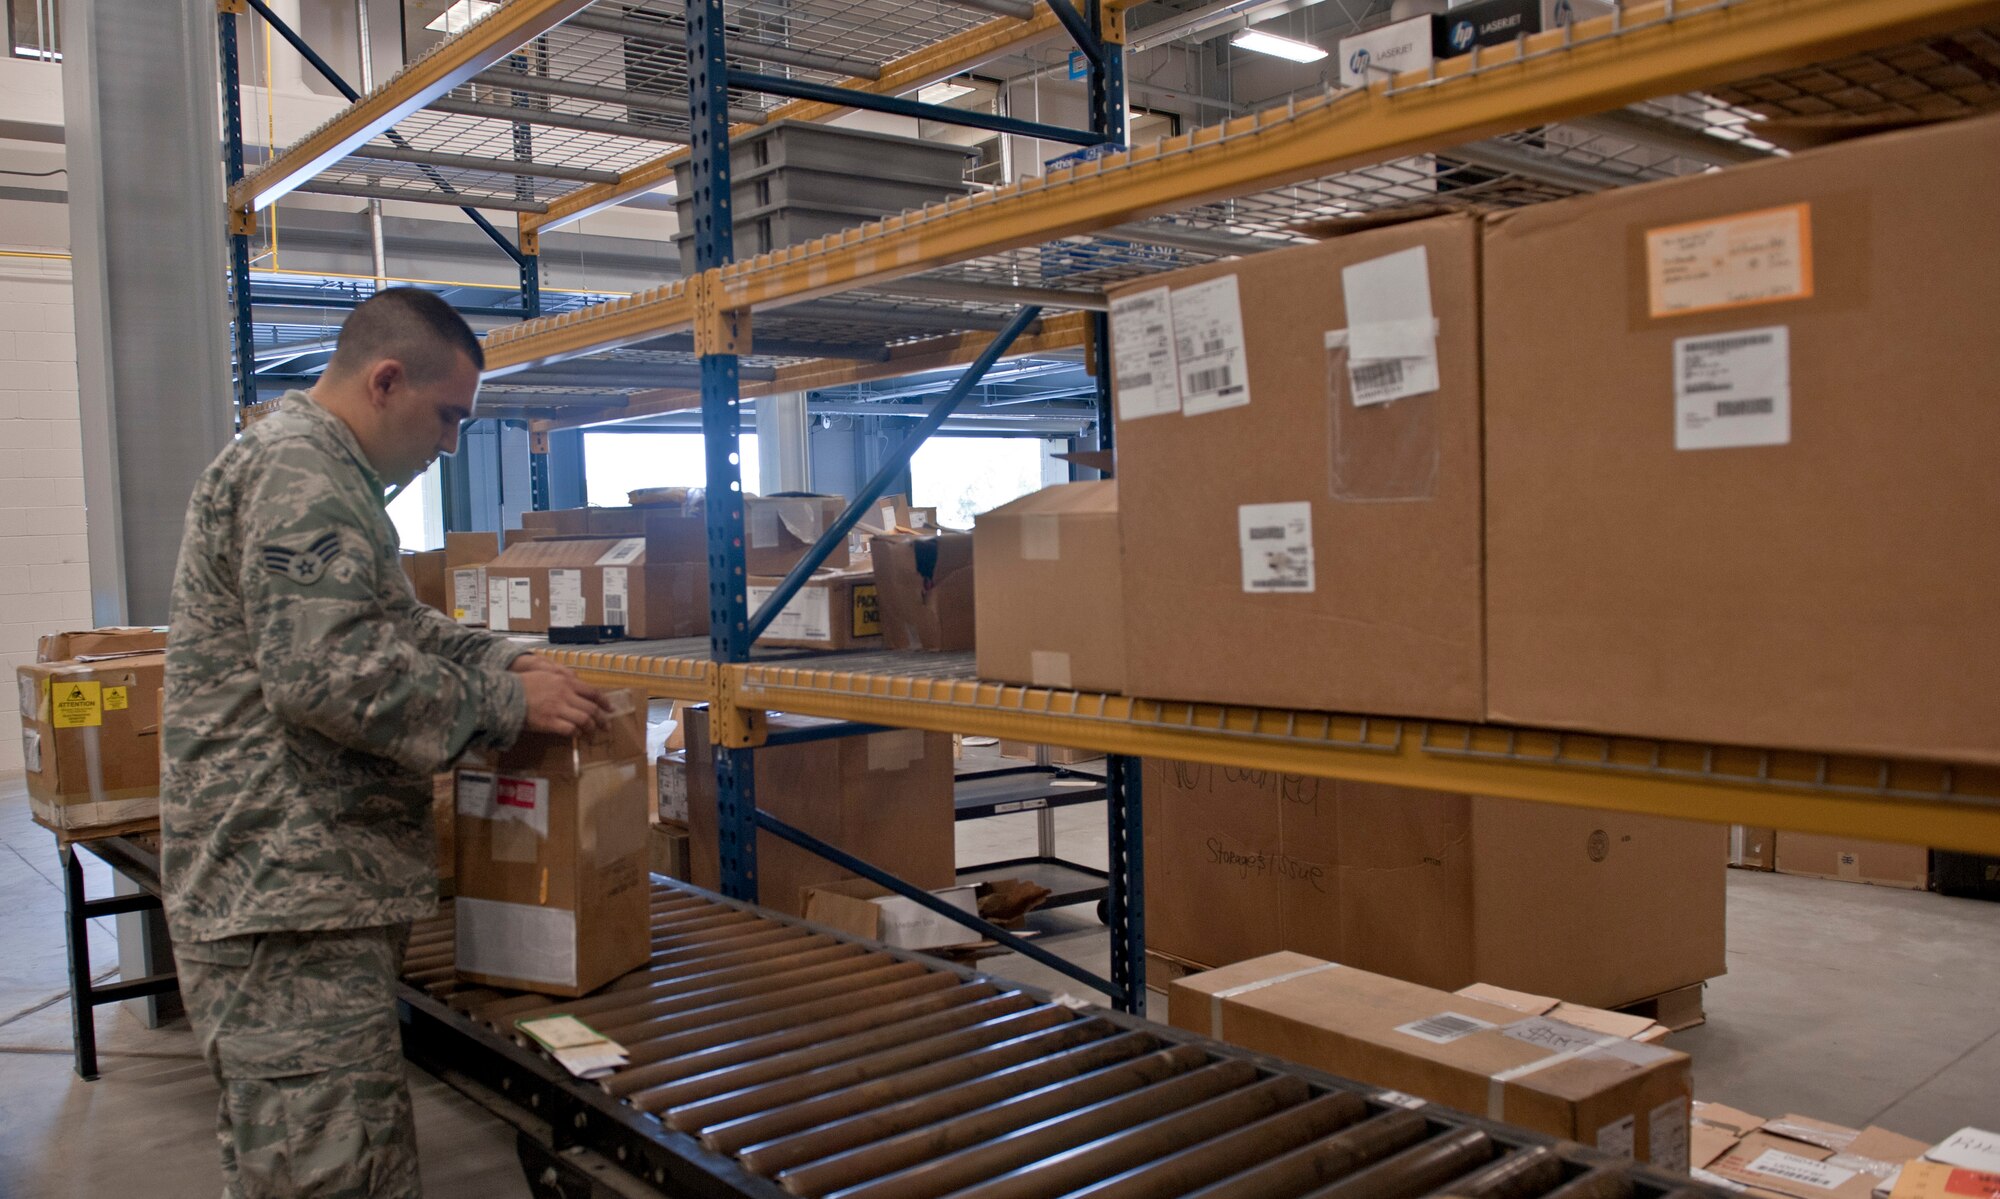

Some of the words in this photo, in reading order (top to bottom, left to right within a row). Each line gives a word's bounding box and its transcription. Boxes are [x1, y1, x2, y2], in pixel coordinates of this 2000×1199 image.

[1452, 21, 1476, 50] hp
[1480, 14, 1522, 34] LASERJET
[1350, 49, 1370, 74] hp
[1376, 43, 1414, 61] LASERJET
[57, 700, 96, 708] ATTENTION
